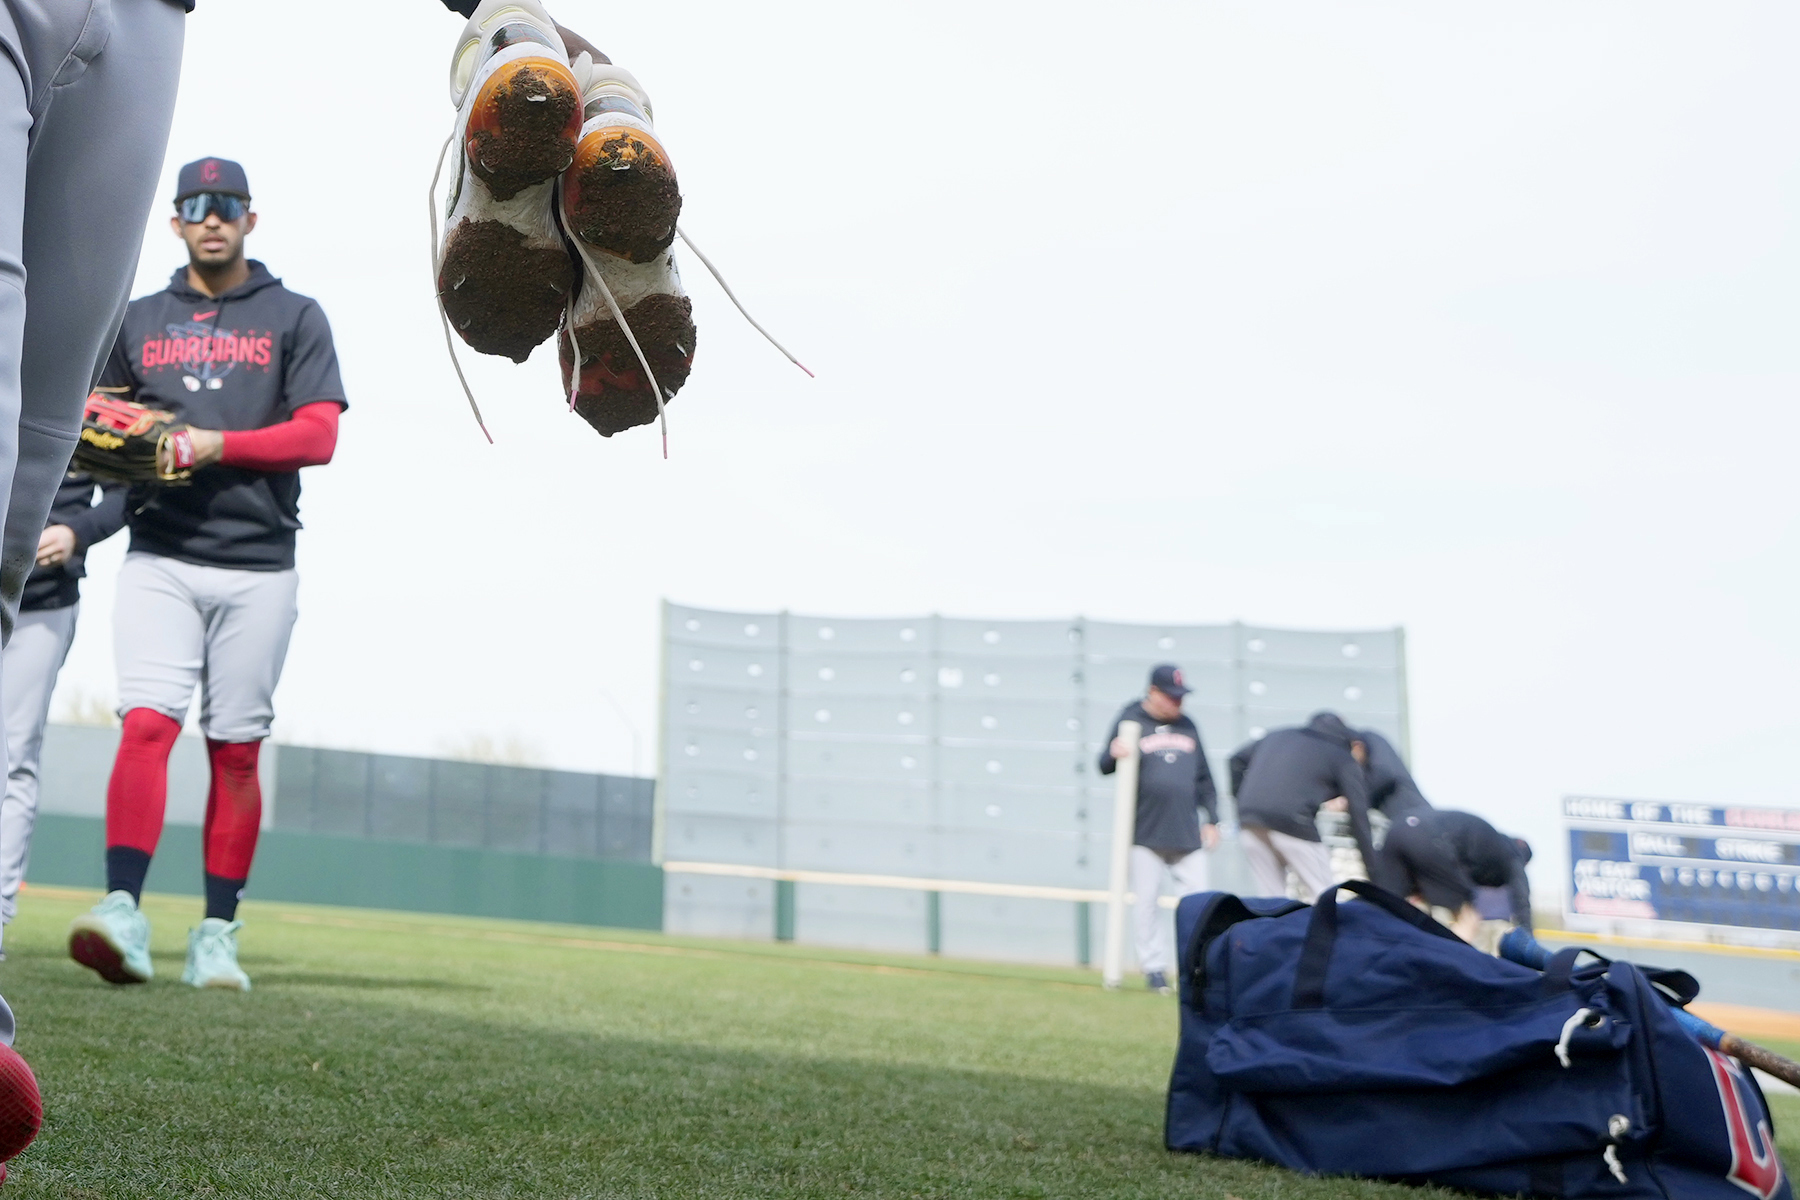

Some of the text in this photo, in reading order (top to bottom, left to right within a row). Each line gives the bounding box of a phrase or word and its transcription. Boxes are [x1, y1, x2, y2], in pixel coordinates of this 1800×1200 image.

[201, 161, 220, 184] C
[142, 336, 272, 368] GUARDIANS
[1702, 1046, 1781, 1199] C
